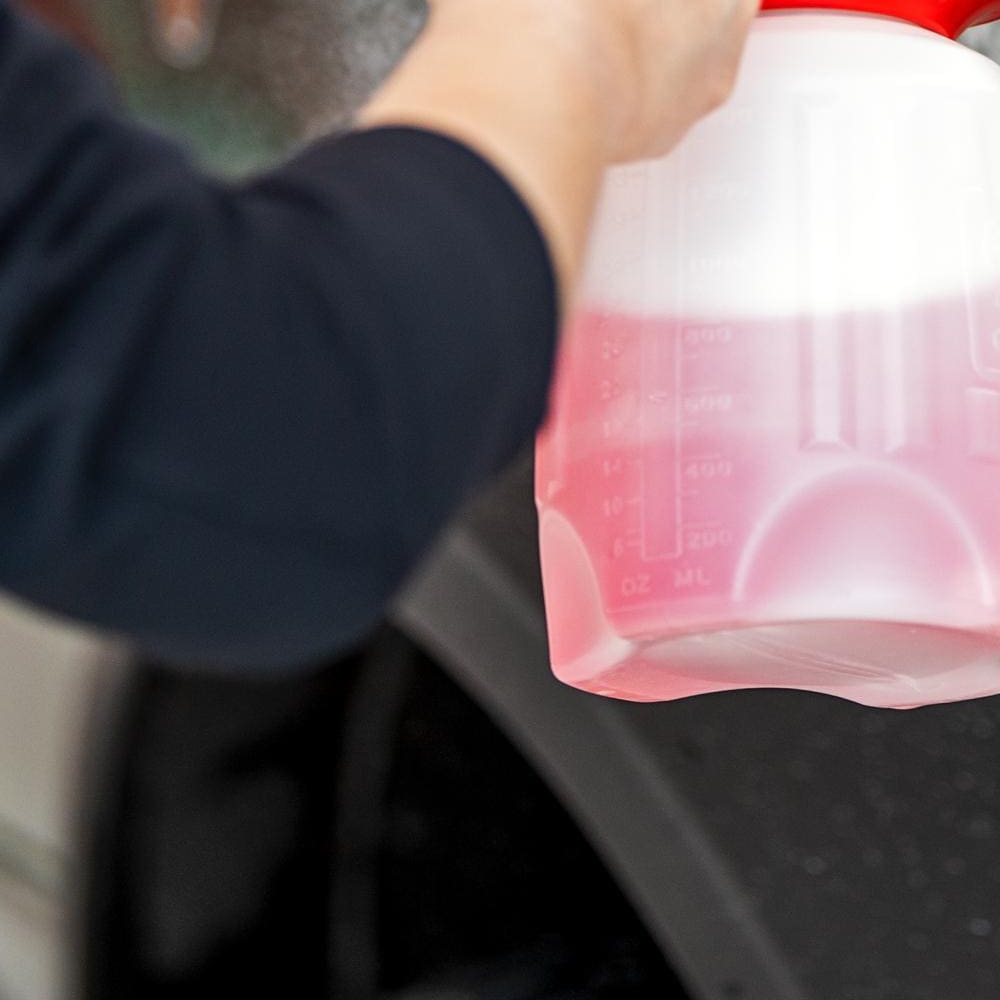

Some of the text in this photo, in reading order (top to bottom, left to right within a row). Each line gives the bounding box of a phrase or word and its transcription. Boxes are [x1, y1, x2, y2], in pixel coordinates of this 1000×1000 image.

[685, 460, 734, 480] 400
[602, 495, 625, 518] 10
[686, 530, 733, 551] 200
[620, 572, 653, 598] OZ
[673, 566, 712, 588] ML
